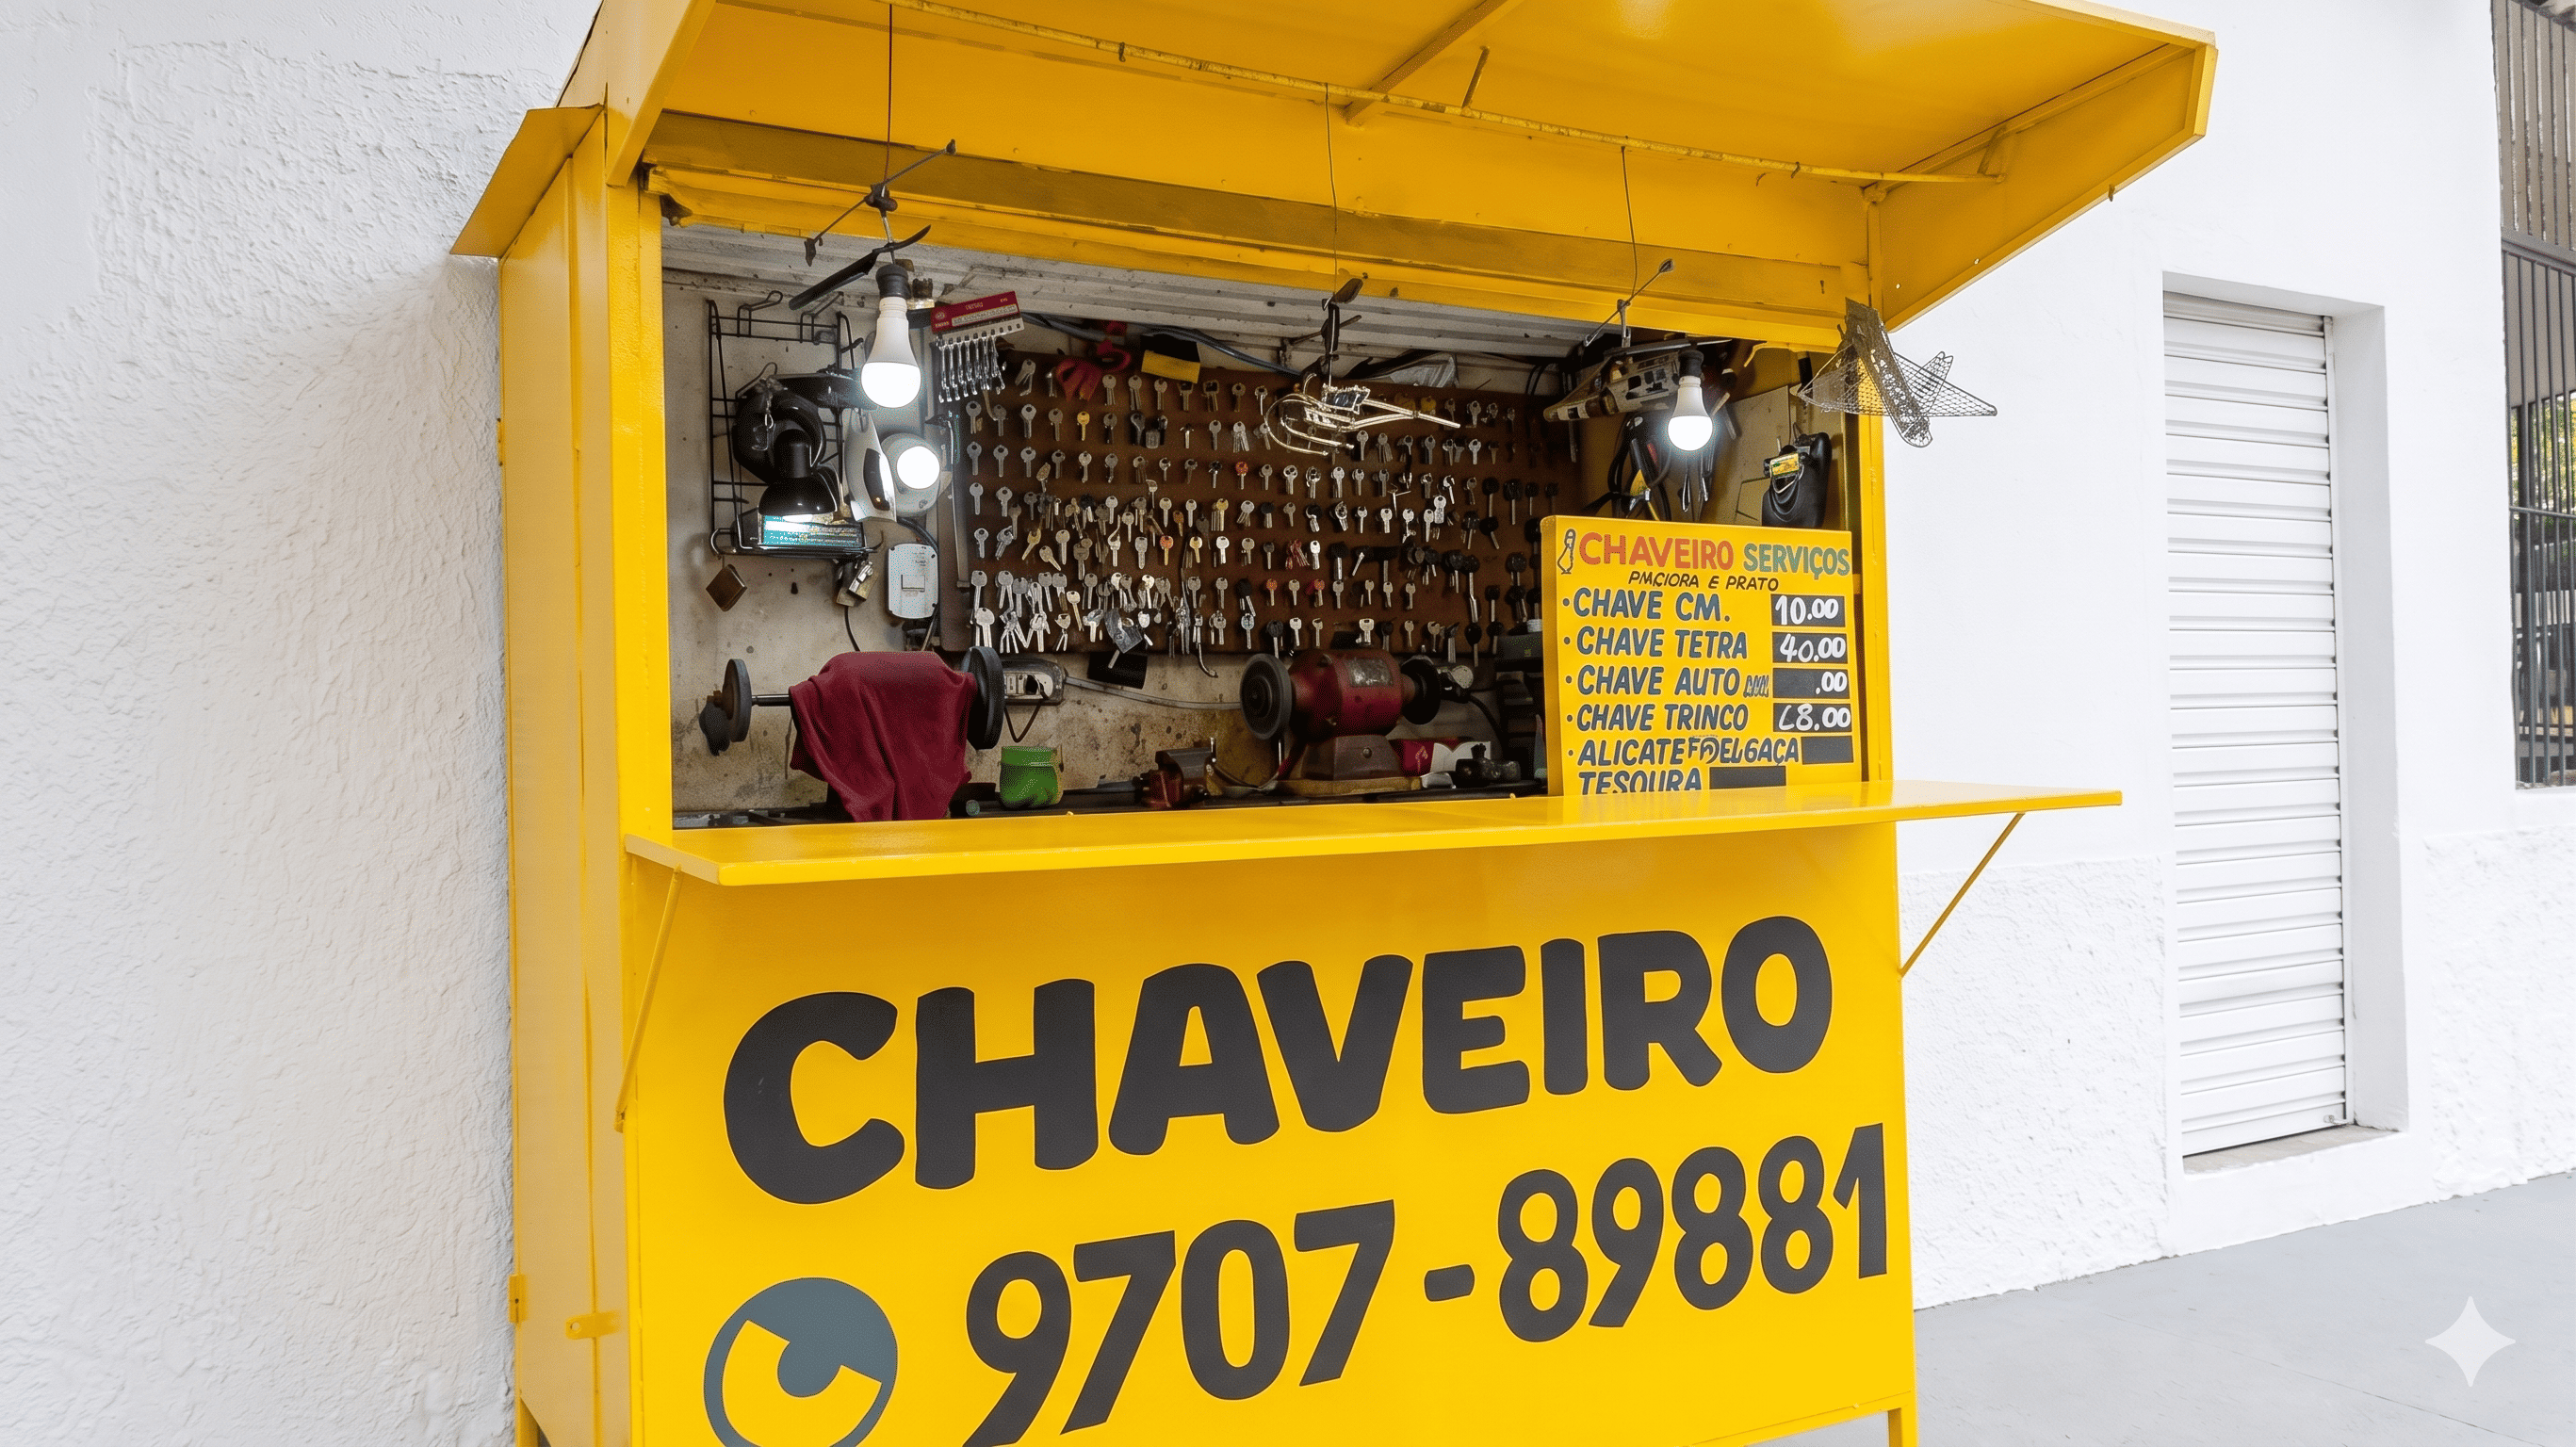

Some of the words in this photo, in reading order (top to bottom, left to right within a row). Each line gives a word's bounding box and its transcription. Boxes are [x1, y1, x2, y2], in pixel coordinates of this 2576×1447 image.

[1579, 531, 1735, 571] CHAVEIRO
[1743, 543, 1850, 580] SERVIÇOS
[1707, 575, 1720, 590] E
[1725, 576, 1780, 593] PRATO
[1573, 587, 1664, 620] CHAVE
[1675, 592, 1731, 623] CM.
[1774, 594, 1840, 626] 10.00
[1576, 626, 1665, 658] CHAVE
[1674, 629, 1748, 659] TETRA
[1779, 633, 1847, 663] 40.00
[1576, 664, 1665, 696] CHAVE
[1673, 666, 1741, 697] AUTO
[1576, 703, 1656, 732] CHAVE
[1663, 703, 1750, 732] TRINCO
[1578, 767, 1703, 795] TESOURA
[723, 916, 1834, 1205] CHAVEIRO
